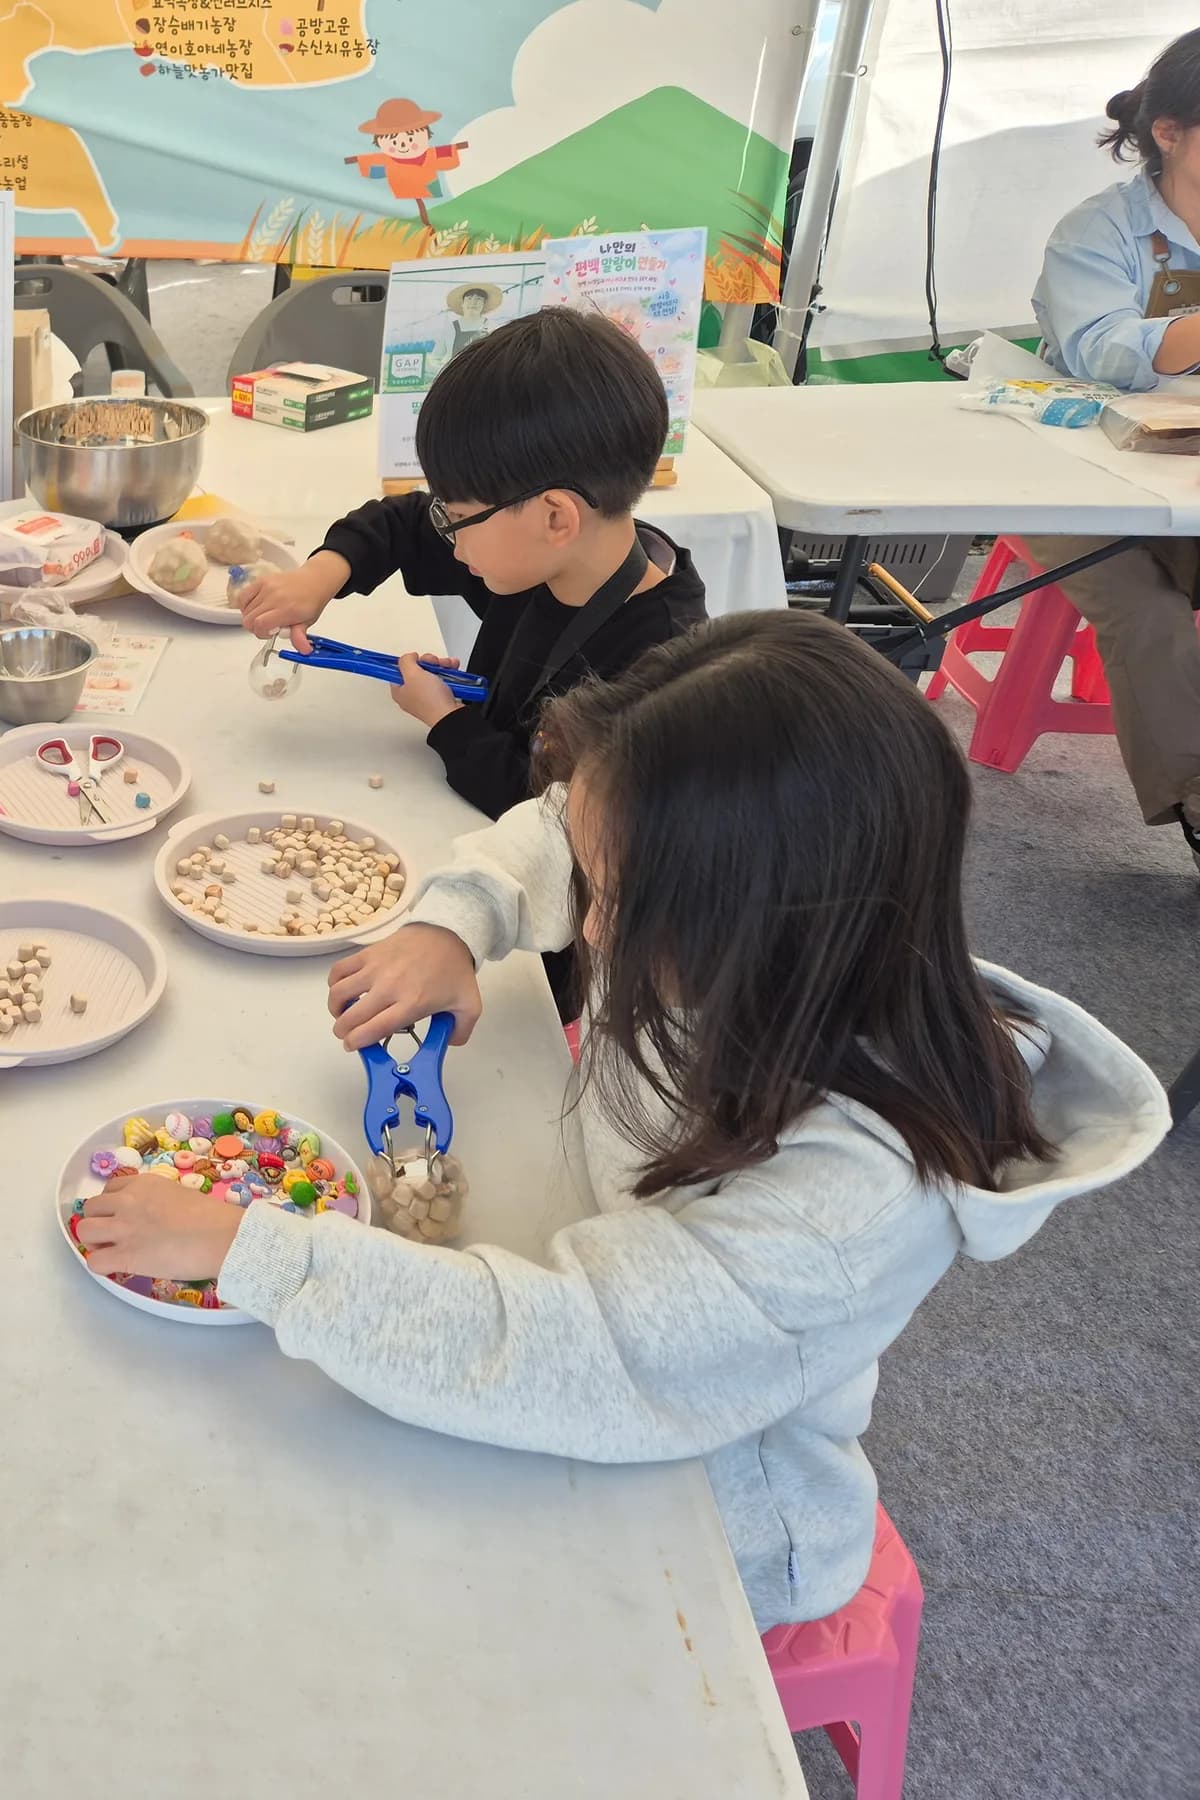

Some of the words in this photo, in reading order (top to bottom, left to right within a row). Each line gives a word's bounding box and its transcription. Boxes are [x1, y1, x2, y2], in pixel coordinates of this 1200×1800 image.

[153, 17, 236, 35] 장승배기농장
[296, 17, 351, 37] 공방고운
[155, 39, 253, 58] 연이호야네농장
[297, 39, 380, 58] 수신치유농장
[157, 63, 253, 80] 하늘맛농가맛집
[600, 241, 636, 254] 나만의
[575, 257, 600, 278] 편백
[601, 256, 636, 273] 말랑이
[395, 359, 419, 368] GAP
